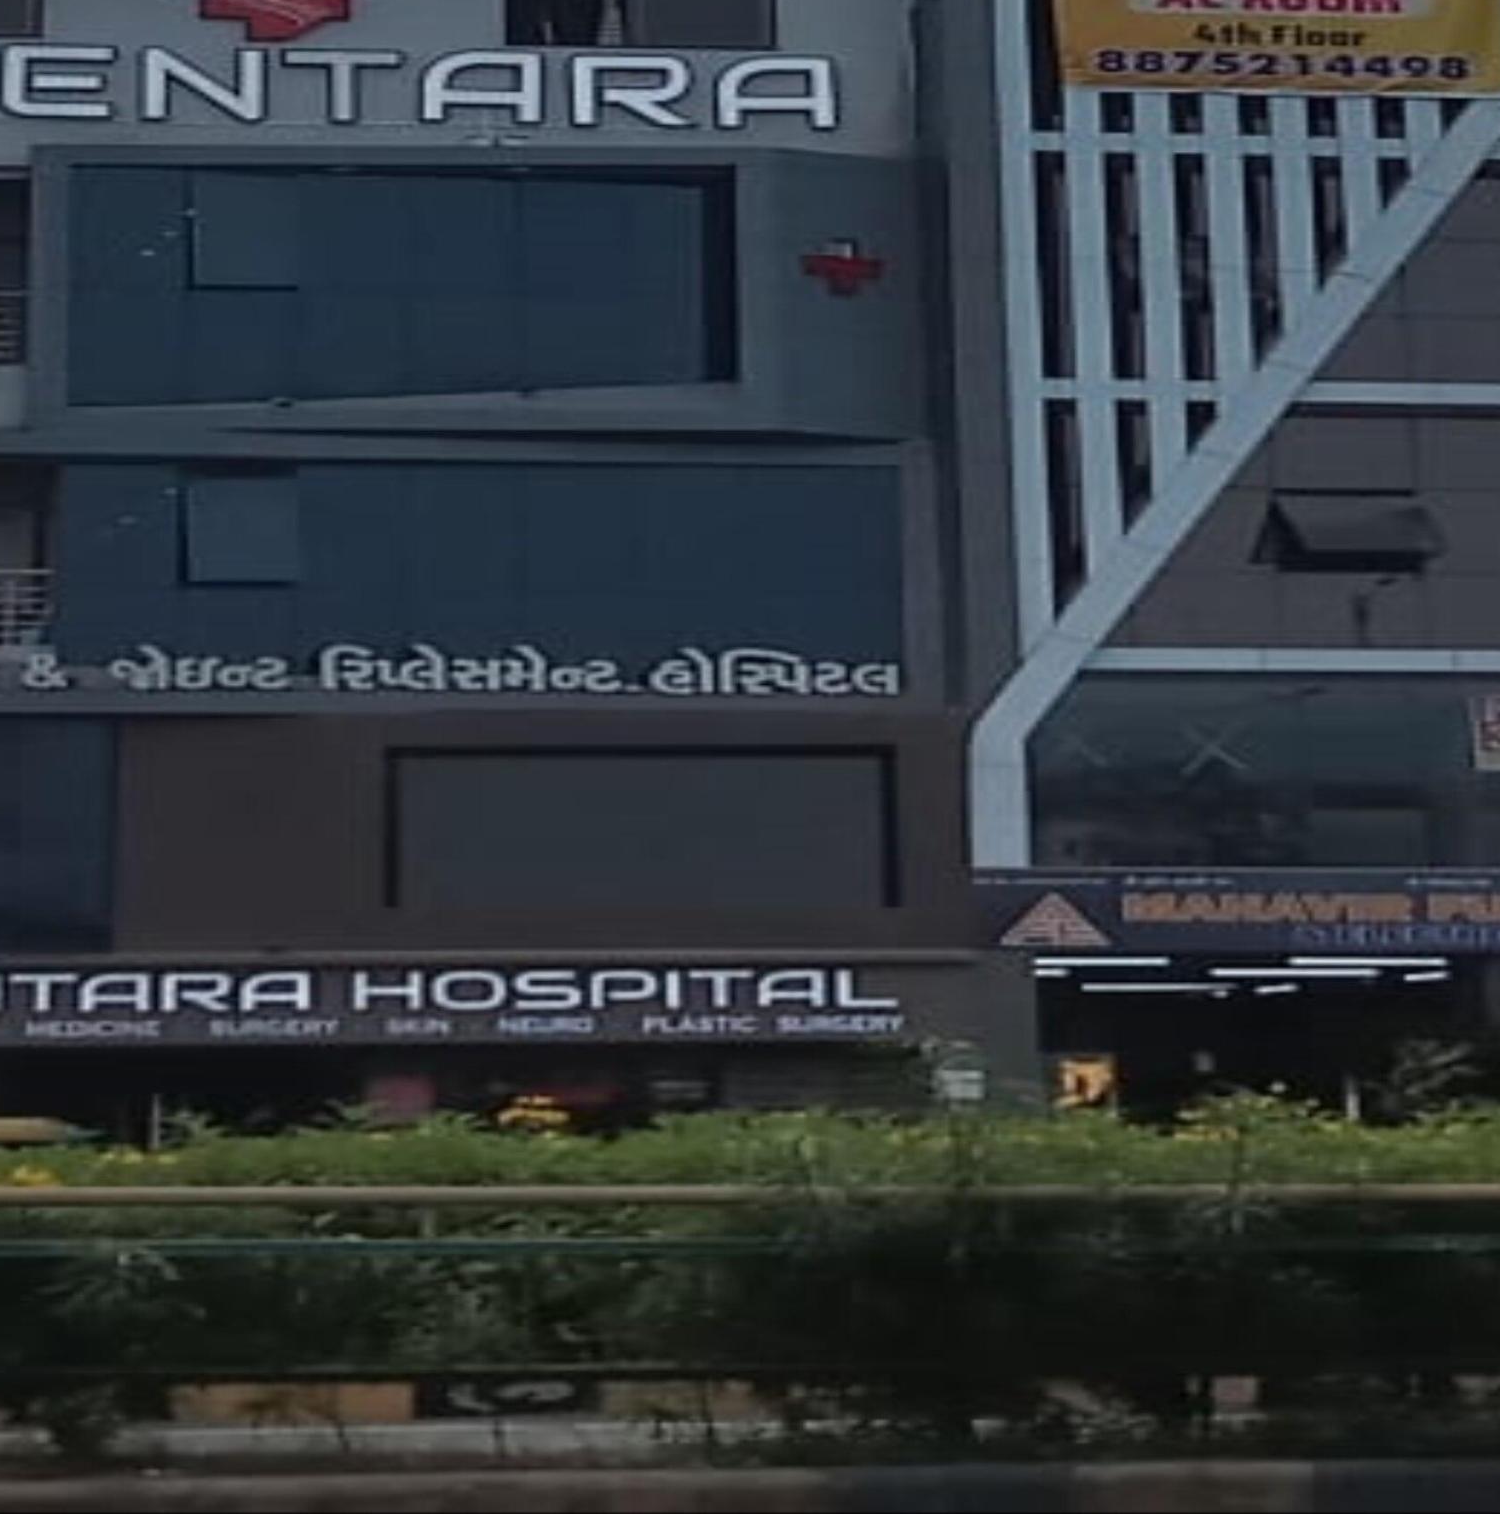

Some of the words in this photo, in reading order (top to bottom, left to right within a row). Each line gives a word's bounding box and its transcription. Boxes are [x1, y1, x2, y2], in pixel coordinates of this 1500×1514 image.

[1192, 22, 1262, 44] 4th
[1097, 51, 1472, 80] 8875214498
[25, 652, 70, 690] &
[647, 647, 900, 697] હોસ્પિટલ
[353, 969, 899, 1011] HOSPITAL
